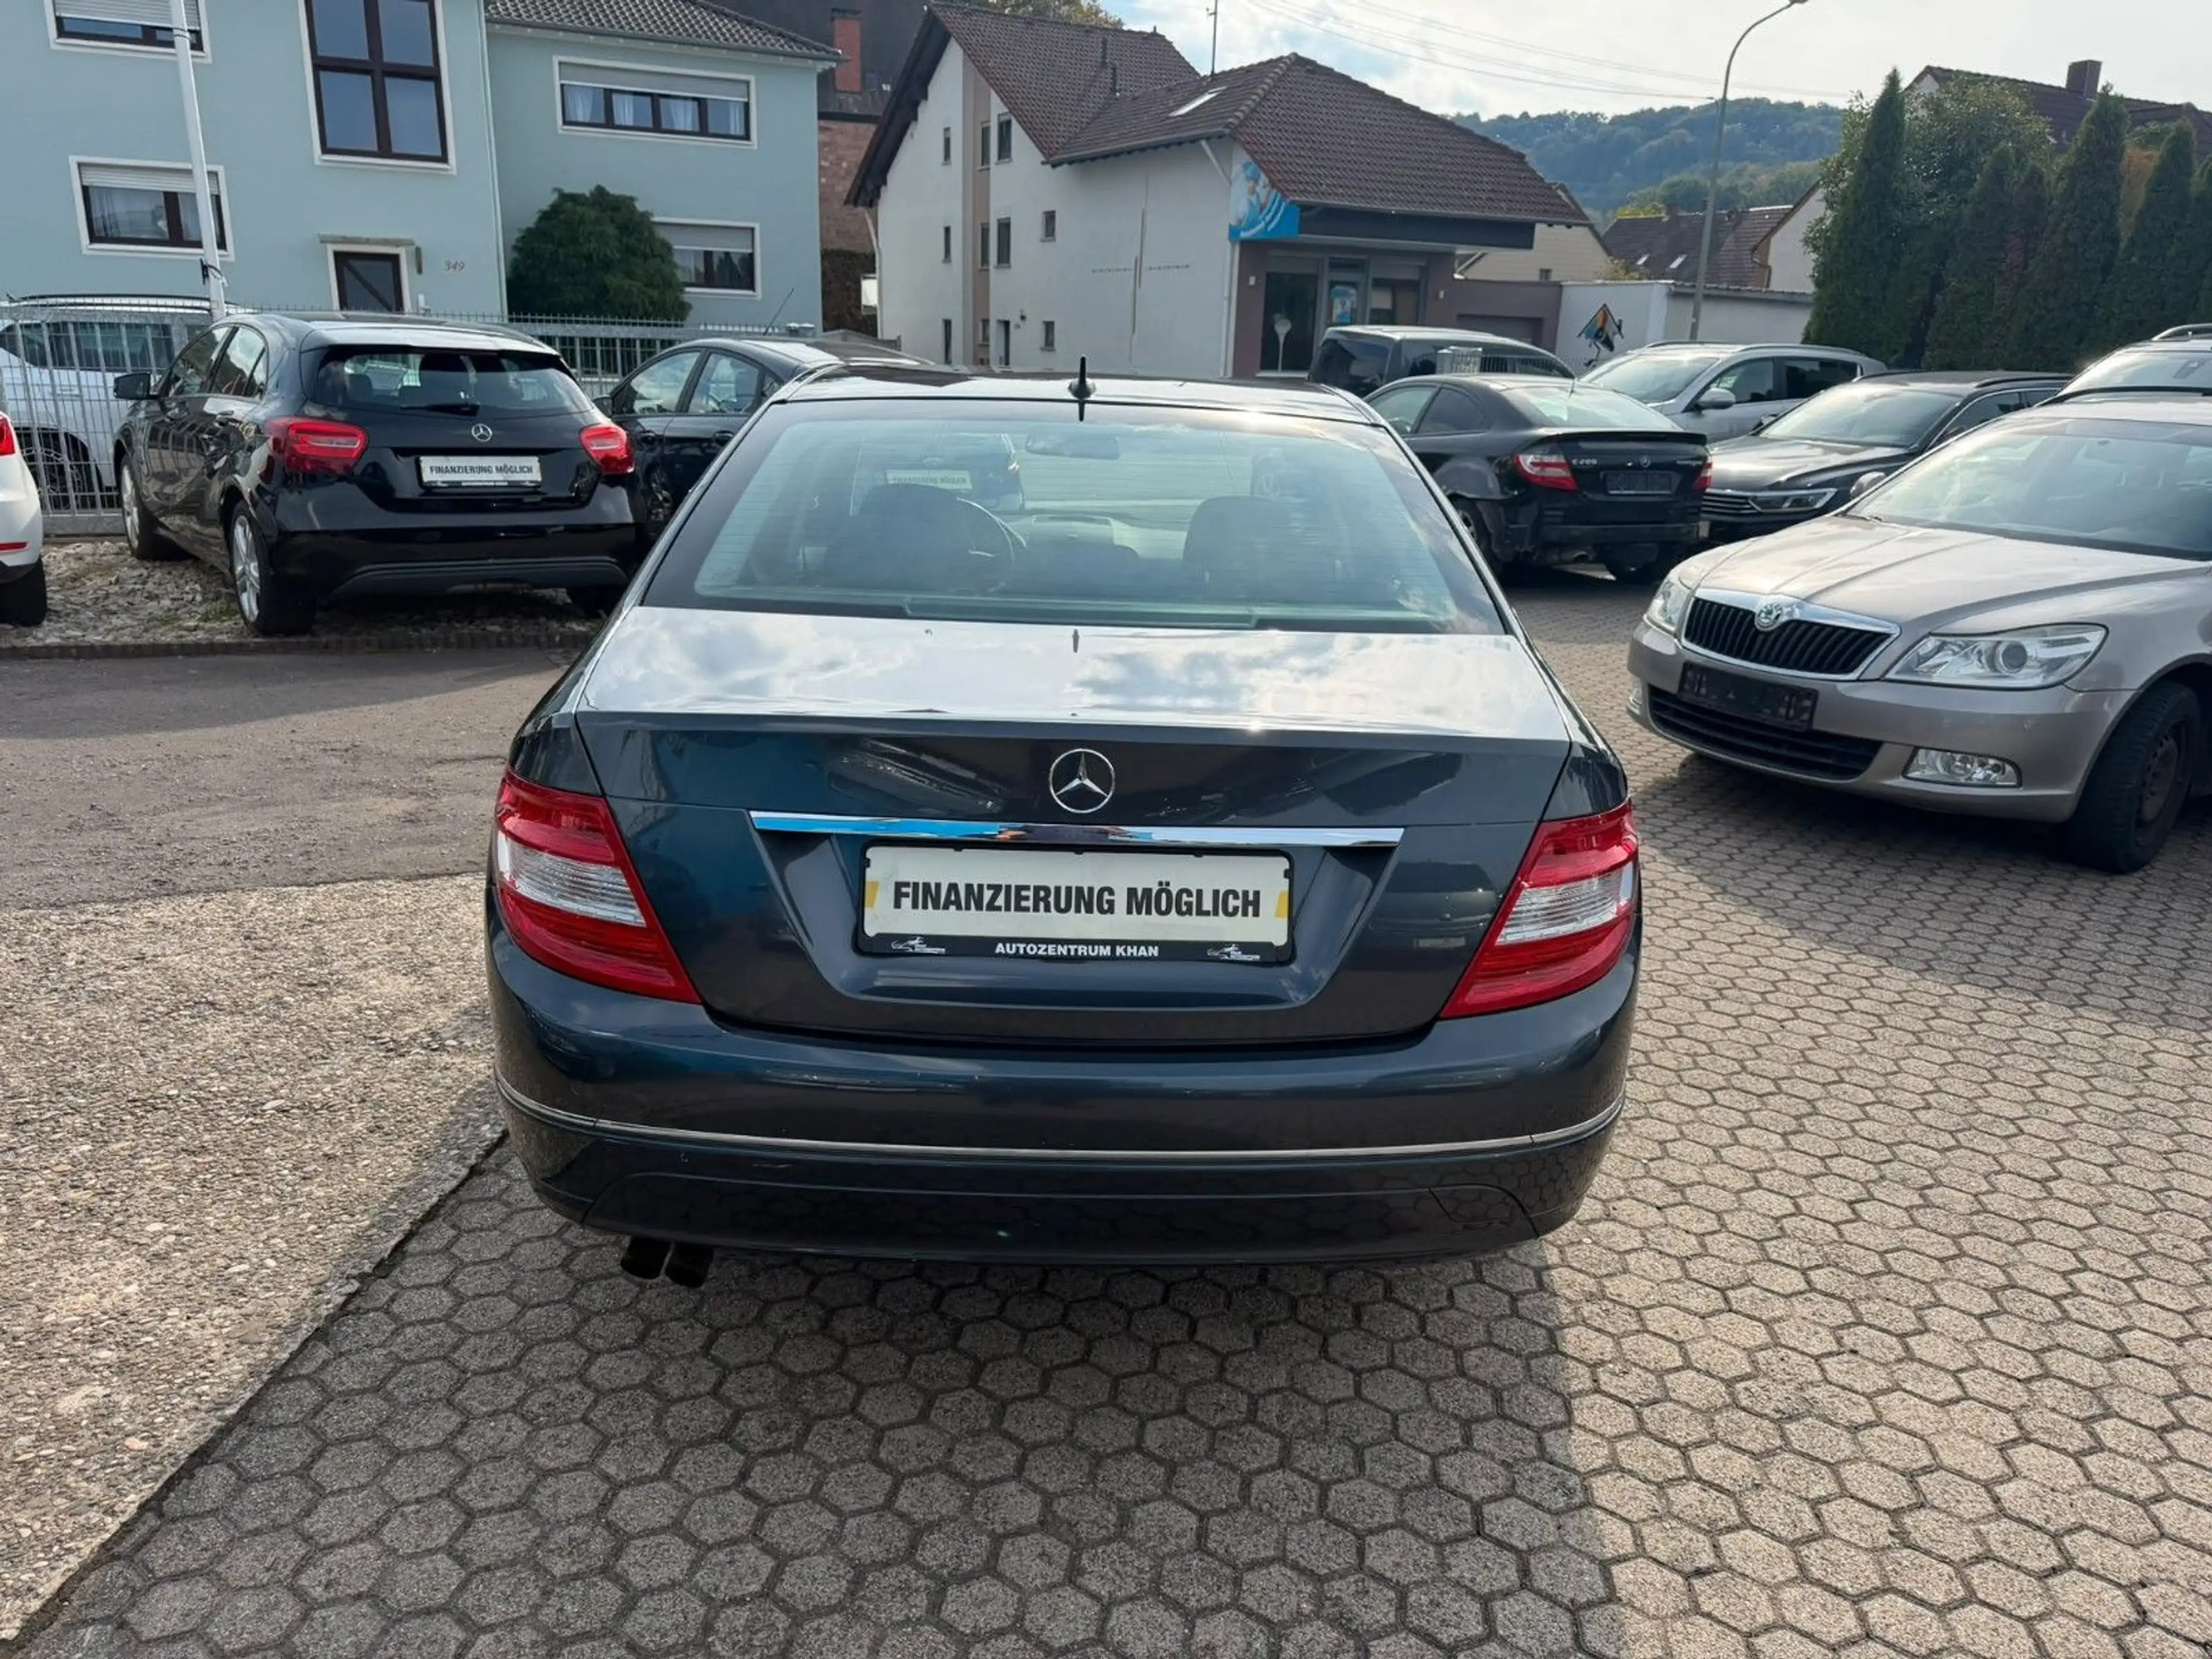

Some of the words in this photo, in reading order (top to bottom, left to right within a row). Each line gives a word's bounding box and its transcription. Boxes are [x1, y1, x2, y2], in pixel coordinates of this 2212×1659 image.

[444, 260, 465, 272] 349
[893, 881, 1115, 915] FINANZIERUNG
[1126, 881, 1260, 917] MÖGLICH
[995, 942, 1111, 956] AUTOZENTRUM
[1115, 945, 1159, 957] KHAN
